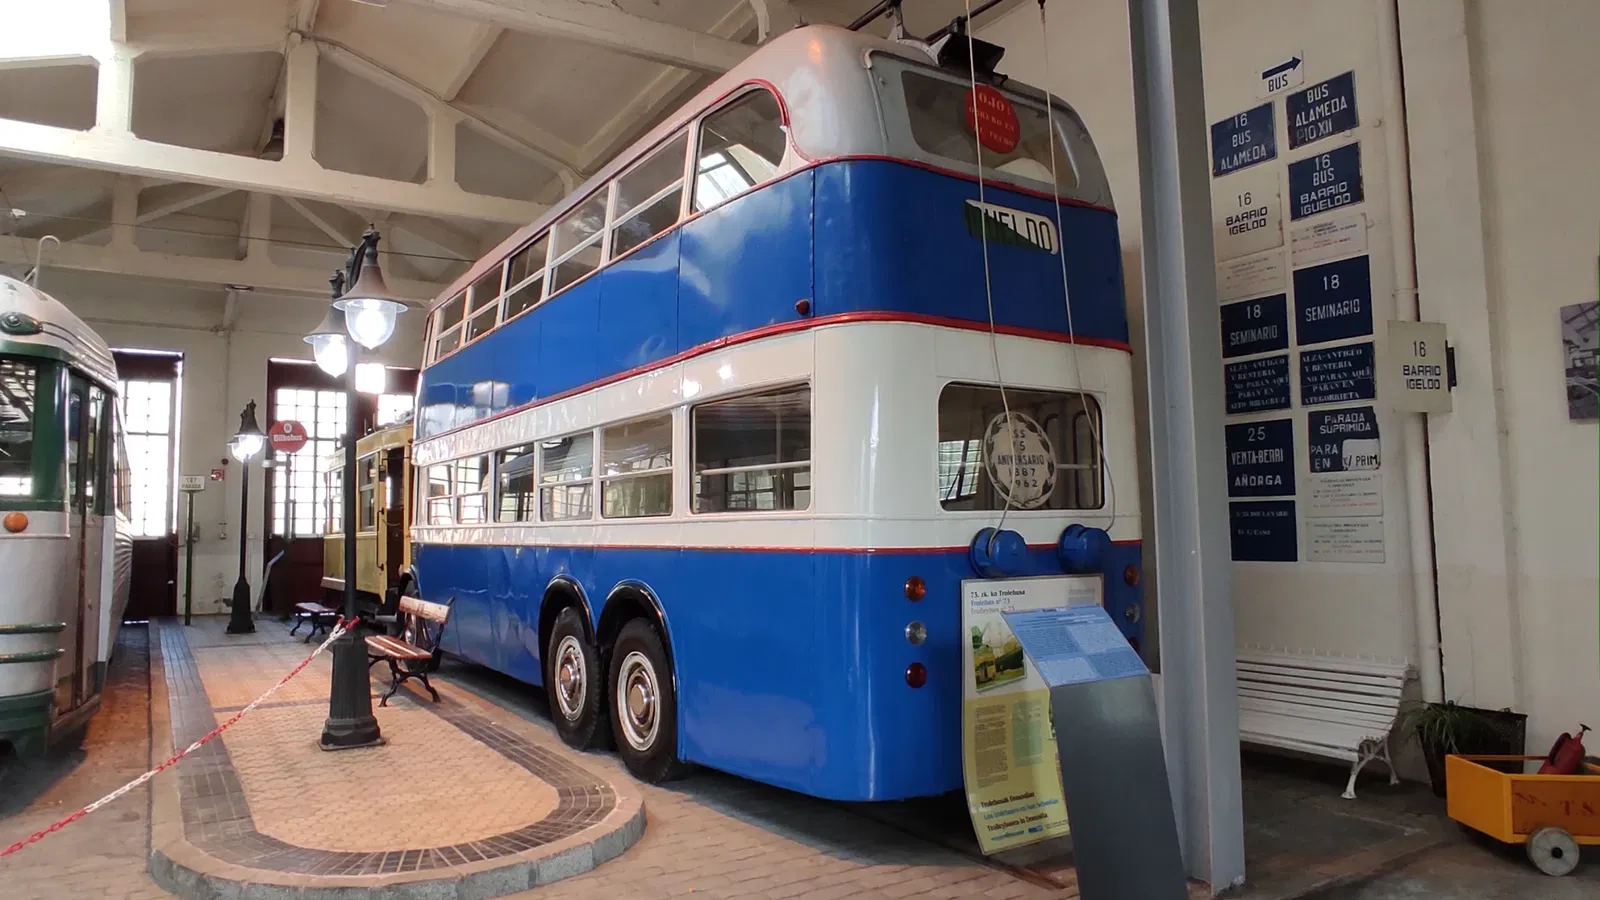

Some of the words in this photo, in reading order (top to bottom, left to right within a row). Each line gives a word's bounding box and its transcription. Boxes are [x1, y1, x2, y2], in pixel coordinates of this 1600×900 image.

[1268, 74, 1289, 93] BUS
[1307, 84, 1329, 104] BUS
[1295, 95, 1348, 128] ALAMEDA
[1234, 113, 1248, 129] 16
[1318, 118, 1333, 137] XII
[1231, 130, 1252, 148] BUS
[1220, 144, 1267, 172] ALAMEDA
[1314, 154, 1331, 172] 16
[1312, 167, 1335, 187] BUS
[1237, 192, 1252, 208] 16
[1300, 181, 1348, 205] BARRIO
[1300, 192, 1351, 216] IGUELDO
[1225, 206, 1268, 228] BARRIO
[1229, 217, 1267, 236] IGELDO
[1322, 274, 1340, 291] 18
[1246, 305, 1261, 320] 18
[1305, 298, 1361, 322] SEMINARIO
[1229, 324, 1278, 347] SEMINARIO
[1412, 341, 1426, 357] 16
[1306, 375, 1317, 383] NO
[1319, 371, 1349, 383] PARAN
[1403, 365, 1441, 377] BARRIO
[1312, 382, 1341, 392] PARAN
[1342, 380, 1355, 389] EN
[1406, 378, 1441, 390] IGELDO
[1324, 412, 1365, 425] PARADA
[1248, 427, 1266, 442] 25
[1319, 422, 1371, 435] SUPRIMIDA
[1231, 448, 1284, 465] VENTA-BERRI
[1310, 444, 1338, 455] PARA
[998, 454, 1045, 466] ANIVERSARIO
[1315, 458, 1331, 469] EN
[1234, 473, 1282, 487] AÑORGA
